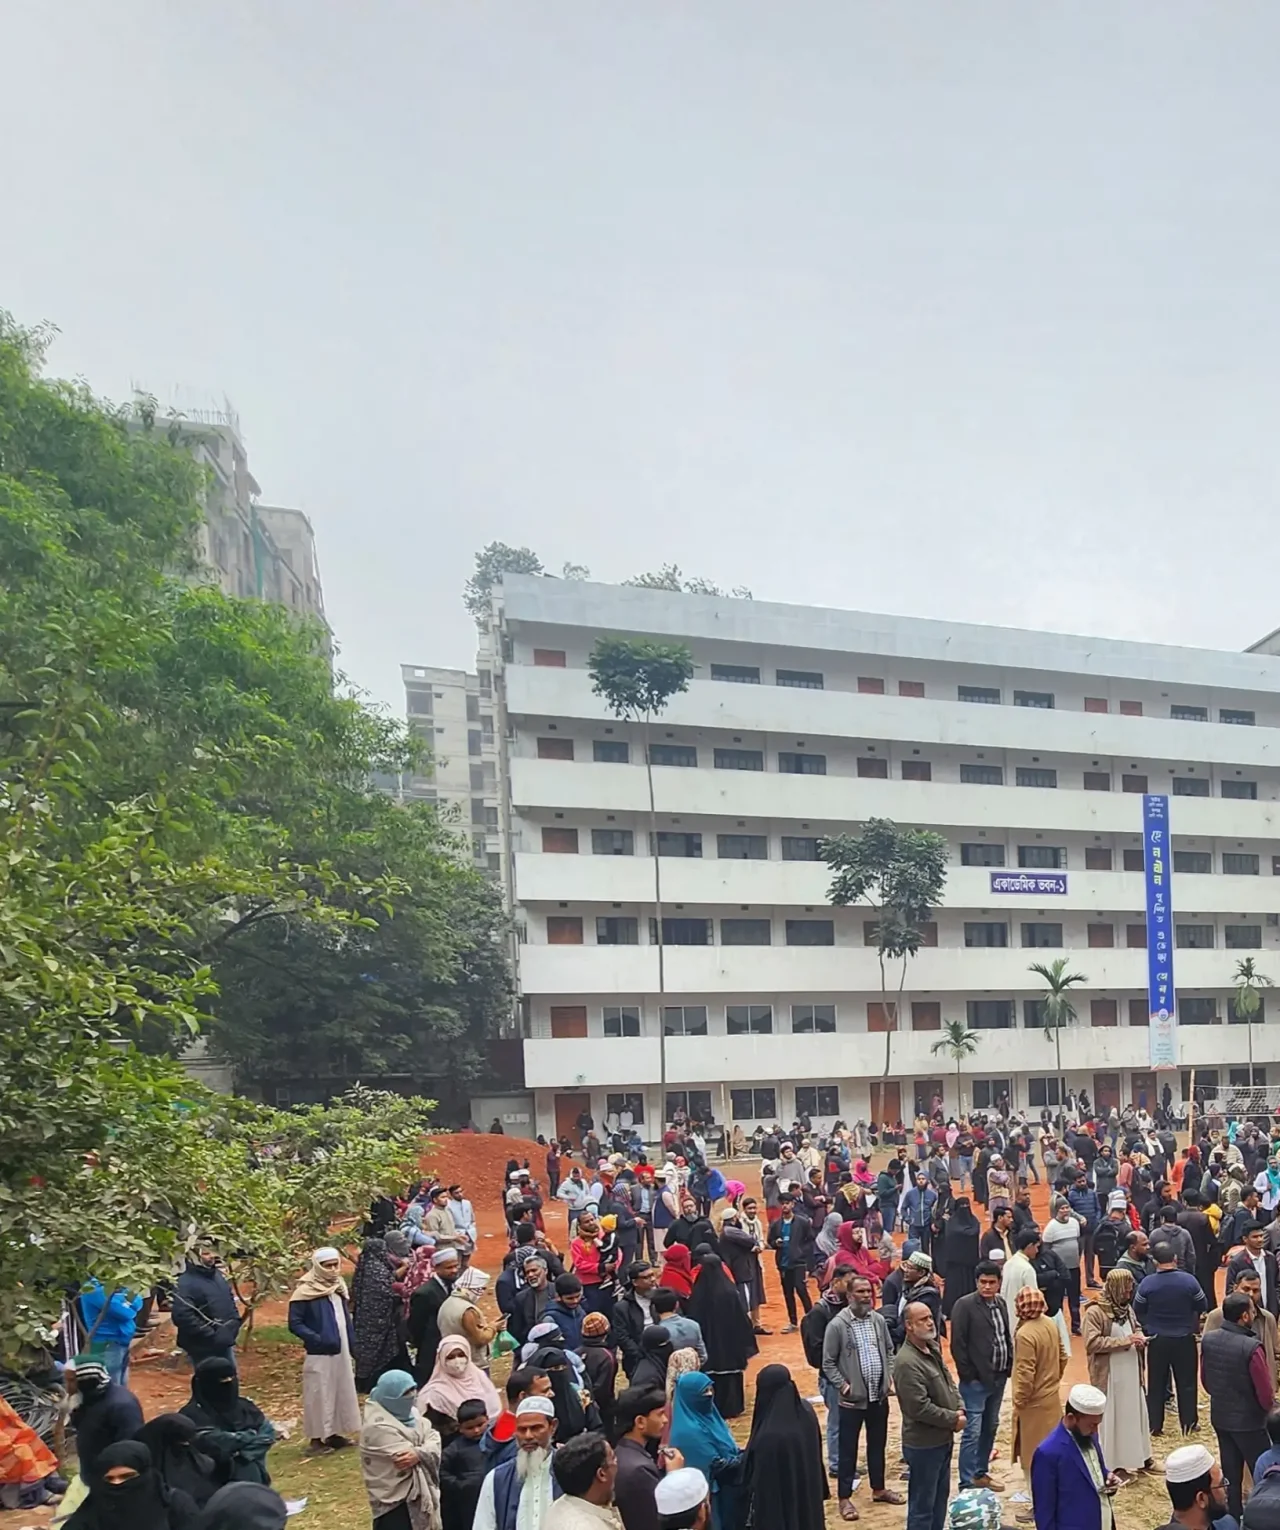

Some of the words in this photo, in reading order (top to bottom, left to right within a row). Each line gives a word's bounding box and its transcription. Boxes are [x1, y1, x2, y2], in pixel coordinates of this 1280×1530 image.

[1151, 830, 1163, 843] হে
[1152, 847, 1163, 886] নবীন
[992, 874, 1036, 892] একাডেমিক
[1037, 879, 1065, 893] ভবন-১
